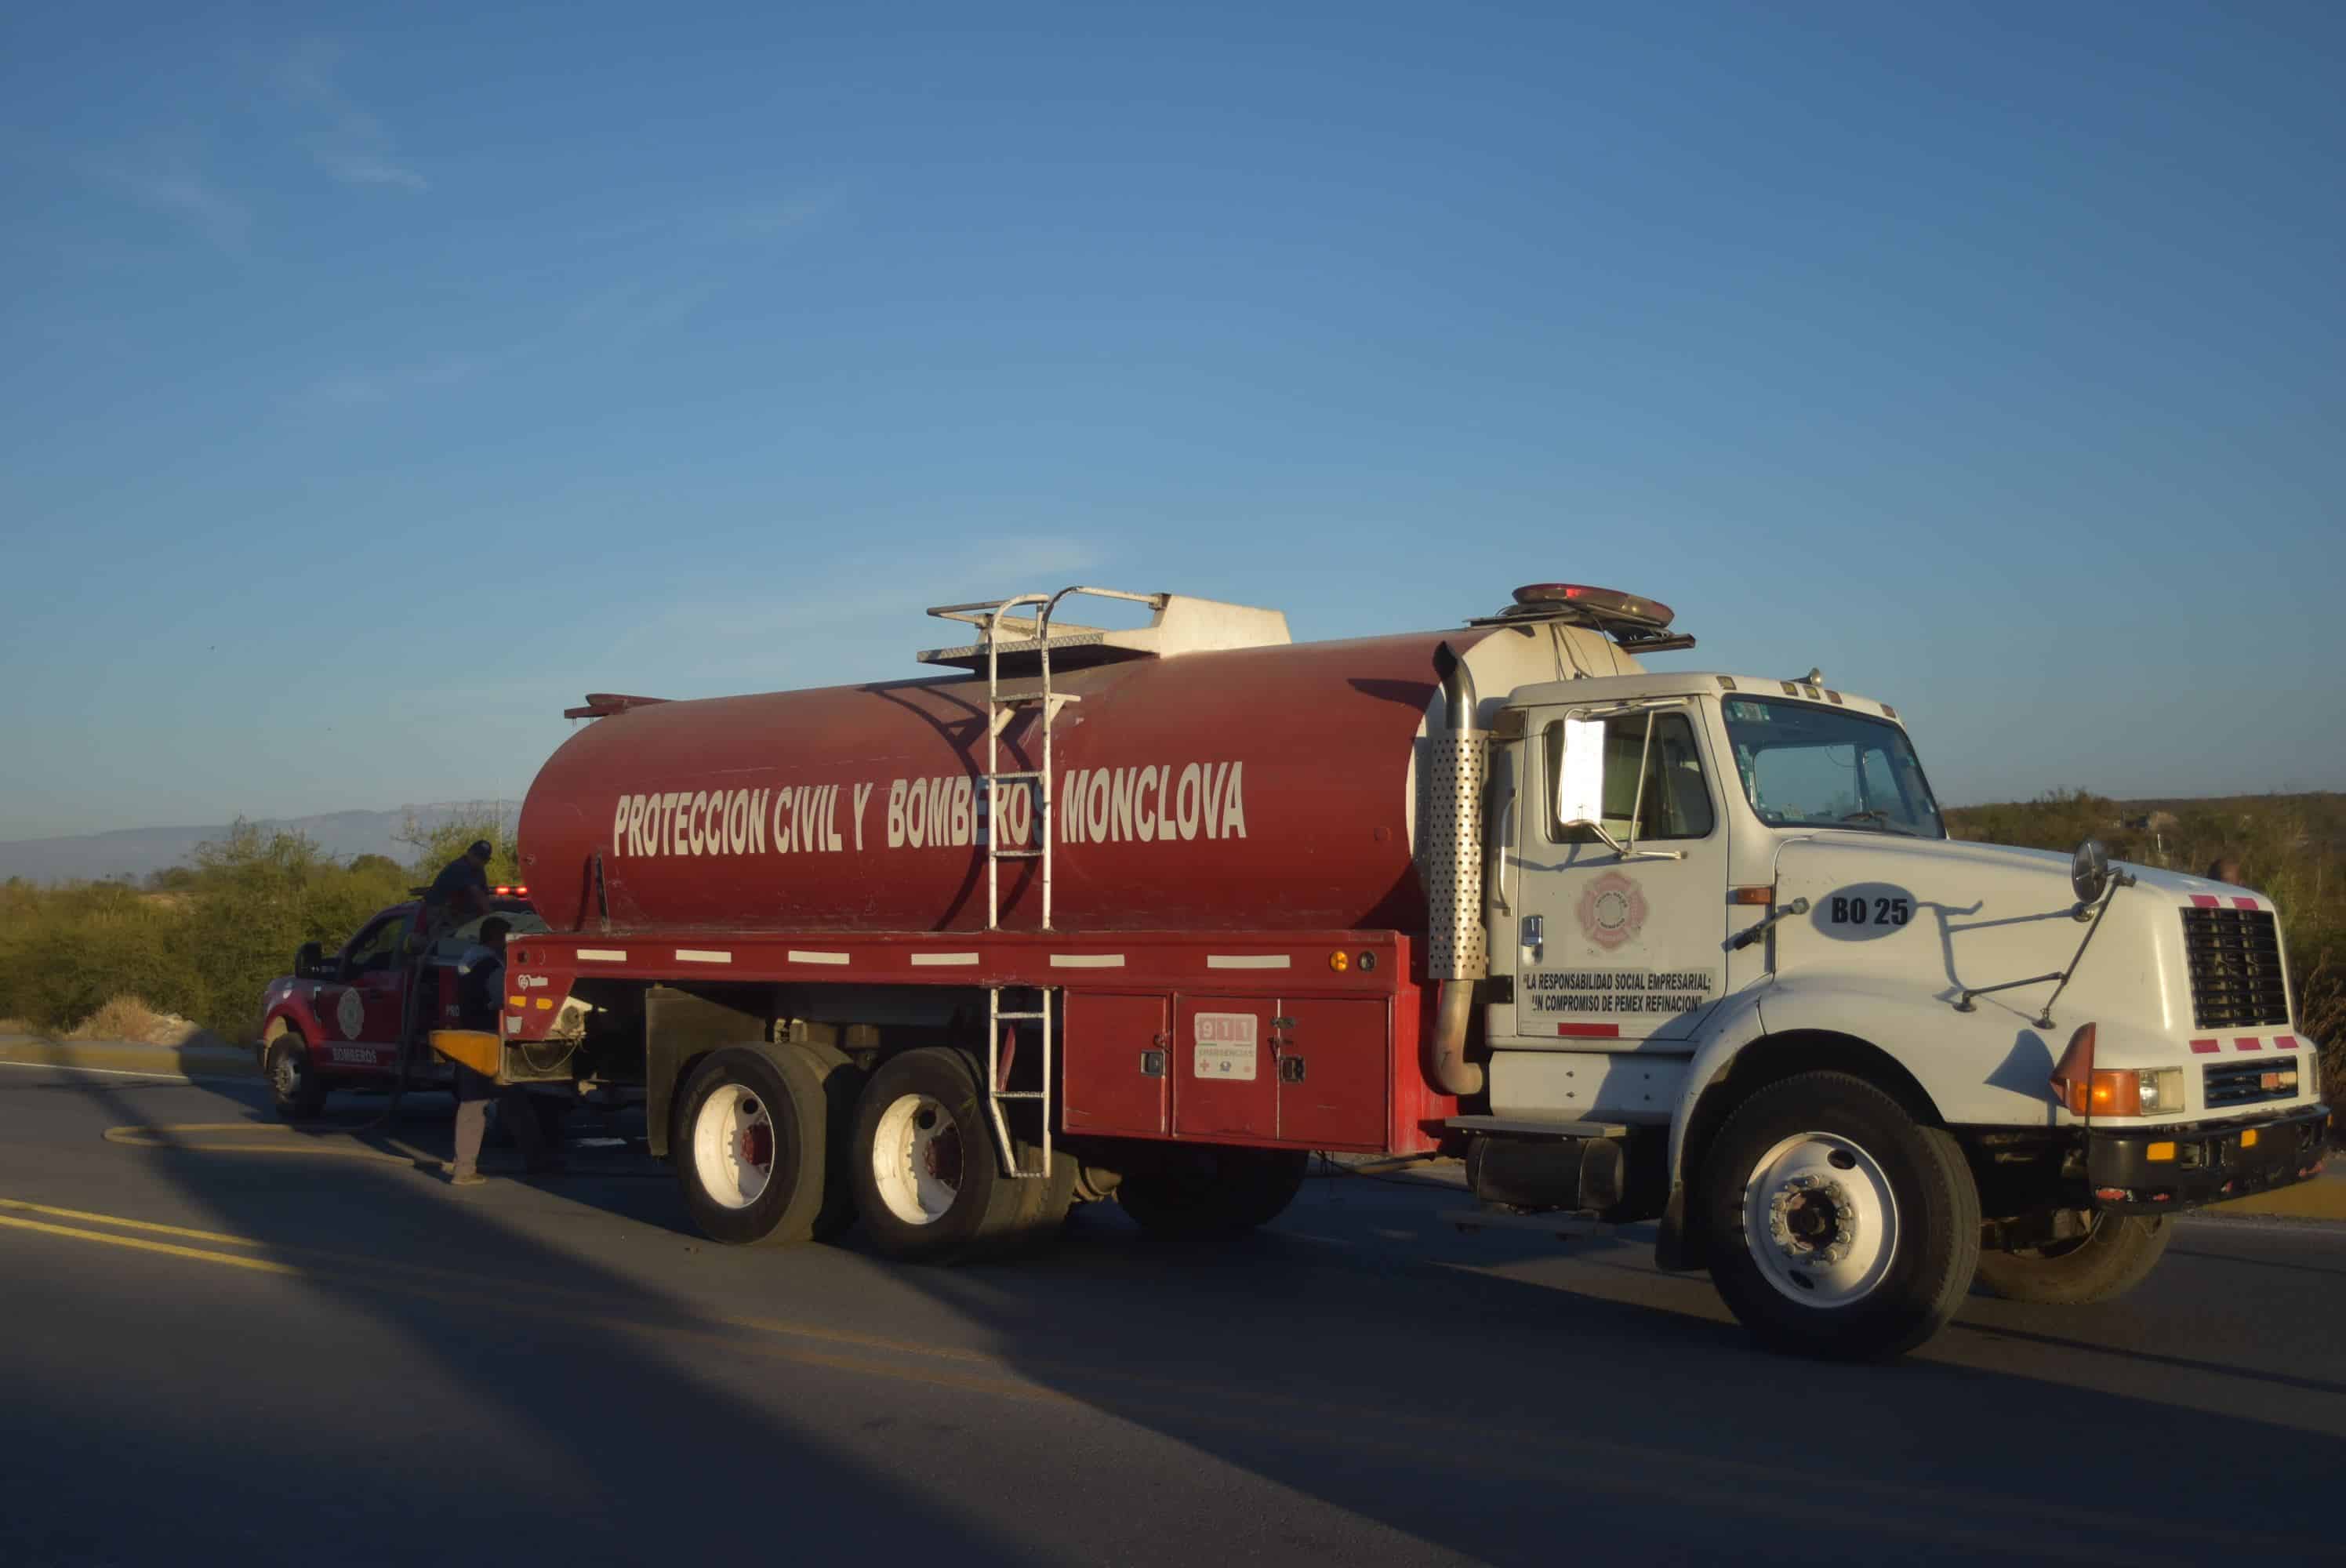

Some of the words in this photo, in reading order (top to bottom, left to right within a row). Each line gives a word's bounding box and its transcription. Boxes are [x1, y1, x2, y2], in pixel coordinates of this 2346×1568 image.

[614, 789, 770, 857] PROTECCION
[774, 785, 843, 853] CIVIL
[854, 782, 873, 851] Y
[1061, 760, 1247, 844] MONCLOVA
[1873, 898, 1908, 925] 25
[1538, 973, 1613, 990] RESPONSABILIDAD
[1614, 974, 1644, 990] SOCIAL
[1647, 973, 1711, 994] EMPRESARIAL;
[1545, 995, 1600, 1011] COMPROMISO
[1601, 996, 1613, 1011] DE
[1614, 996, 1643, 1012] PEMEX
[1203, 1020, 1250, 1038] 911
